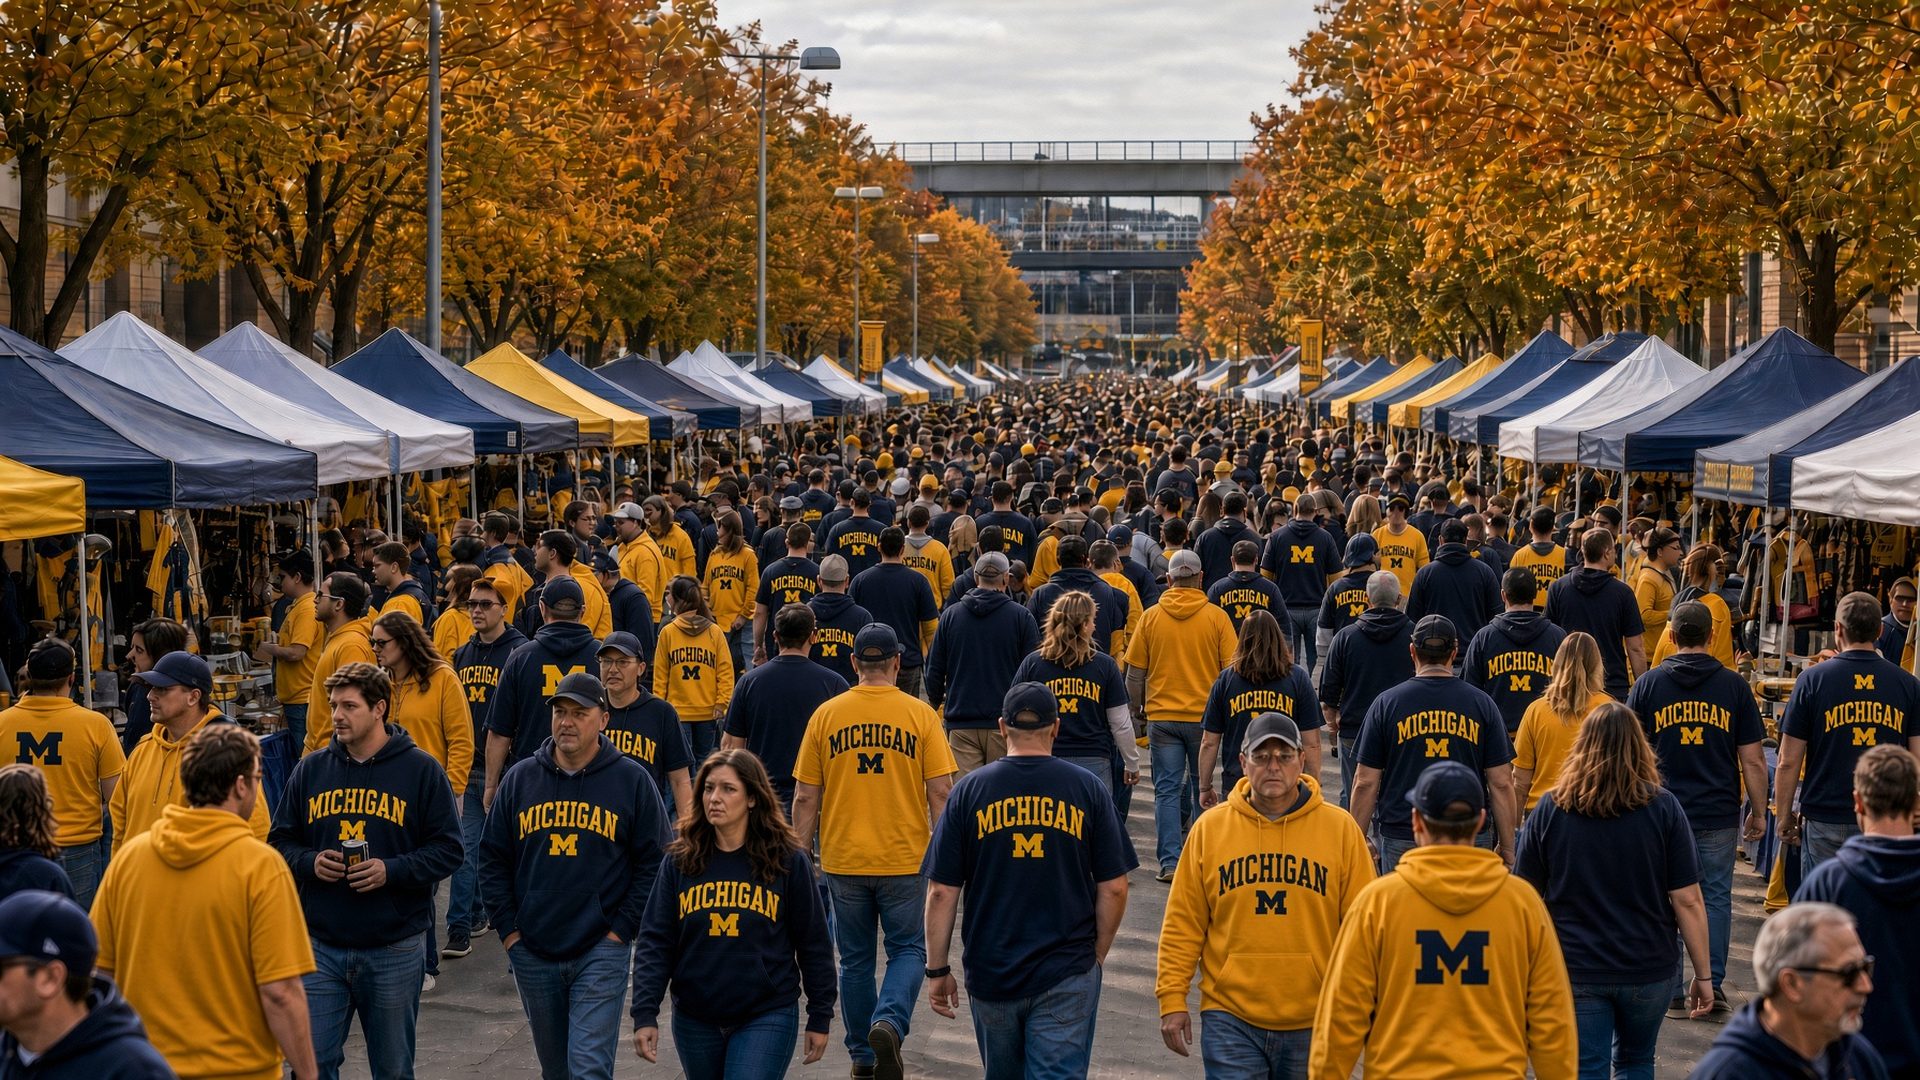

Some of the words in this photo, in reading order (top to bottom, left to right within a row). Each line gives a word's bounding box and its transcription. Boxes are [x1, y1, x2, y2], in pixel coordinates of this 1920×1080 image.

[839, 532, 879, 547] MICHIGAN
[1004, 528, 1023, 545] IGAN
[851, 545, 865, 556] M
[1290, 546, 1314, 564] M
[1390, 558, 1403, 568] M
[719, 580, 732, 590] M
[770, 576, 816, 594] MICHIGAN
[784, 590, 801, 603] M
[1220, 591, 1269, 609] MICHIGAN
[1335, 589, 1369, 609] MICHIG
[1235, 605, 1252, 618] M
[1349, 604, 1365, 617] M
[668, 648, 716, 669] MICHIGAN
[821, 644, 838, 657] M
[542, 665, 586, 696] M
[682, 666, 701, 680] M
[1854, 674, 1875, 690] M
[1510, 675, 1531, 692] M
[469, 686, 486, 702] M
[1230, 690, 1293, 717] MICHIGAN
[1059, 698, 1078, 713] M
[1654, 700, 1731, 733] MICHIGAN
[1825, 701, 1904, 733] MICHIGAN
[1397, 710, 1480, 746] MICHIGAN
[1681, 727, 1704, 745] M
[1853, 727, 1876, 746] M
[15, 732, 63, 765] M
[828, 723, 917, 759] MICHIGAN
[1425, 738, 1449, 758] M
[857, 753, 885, 774] M
[309, 788, 407, 827] MICHIGAN
[519, 801, 619, 842] MICHIGAN
[976, 796, 1085, 840] MICHIGAN
[339, 821, 366, 840] M
[549, 834, 578, 856] M
[1012, 833, 1045, 858] M
[1219, 853, 1328, 897] MICHIGAN
[680, 882, 780, 922] MICHIGAN
[1256, 890, 1288, 915] M
[709, 913, 740, 937] M
[1416, 930, 1490, 985] M
